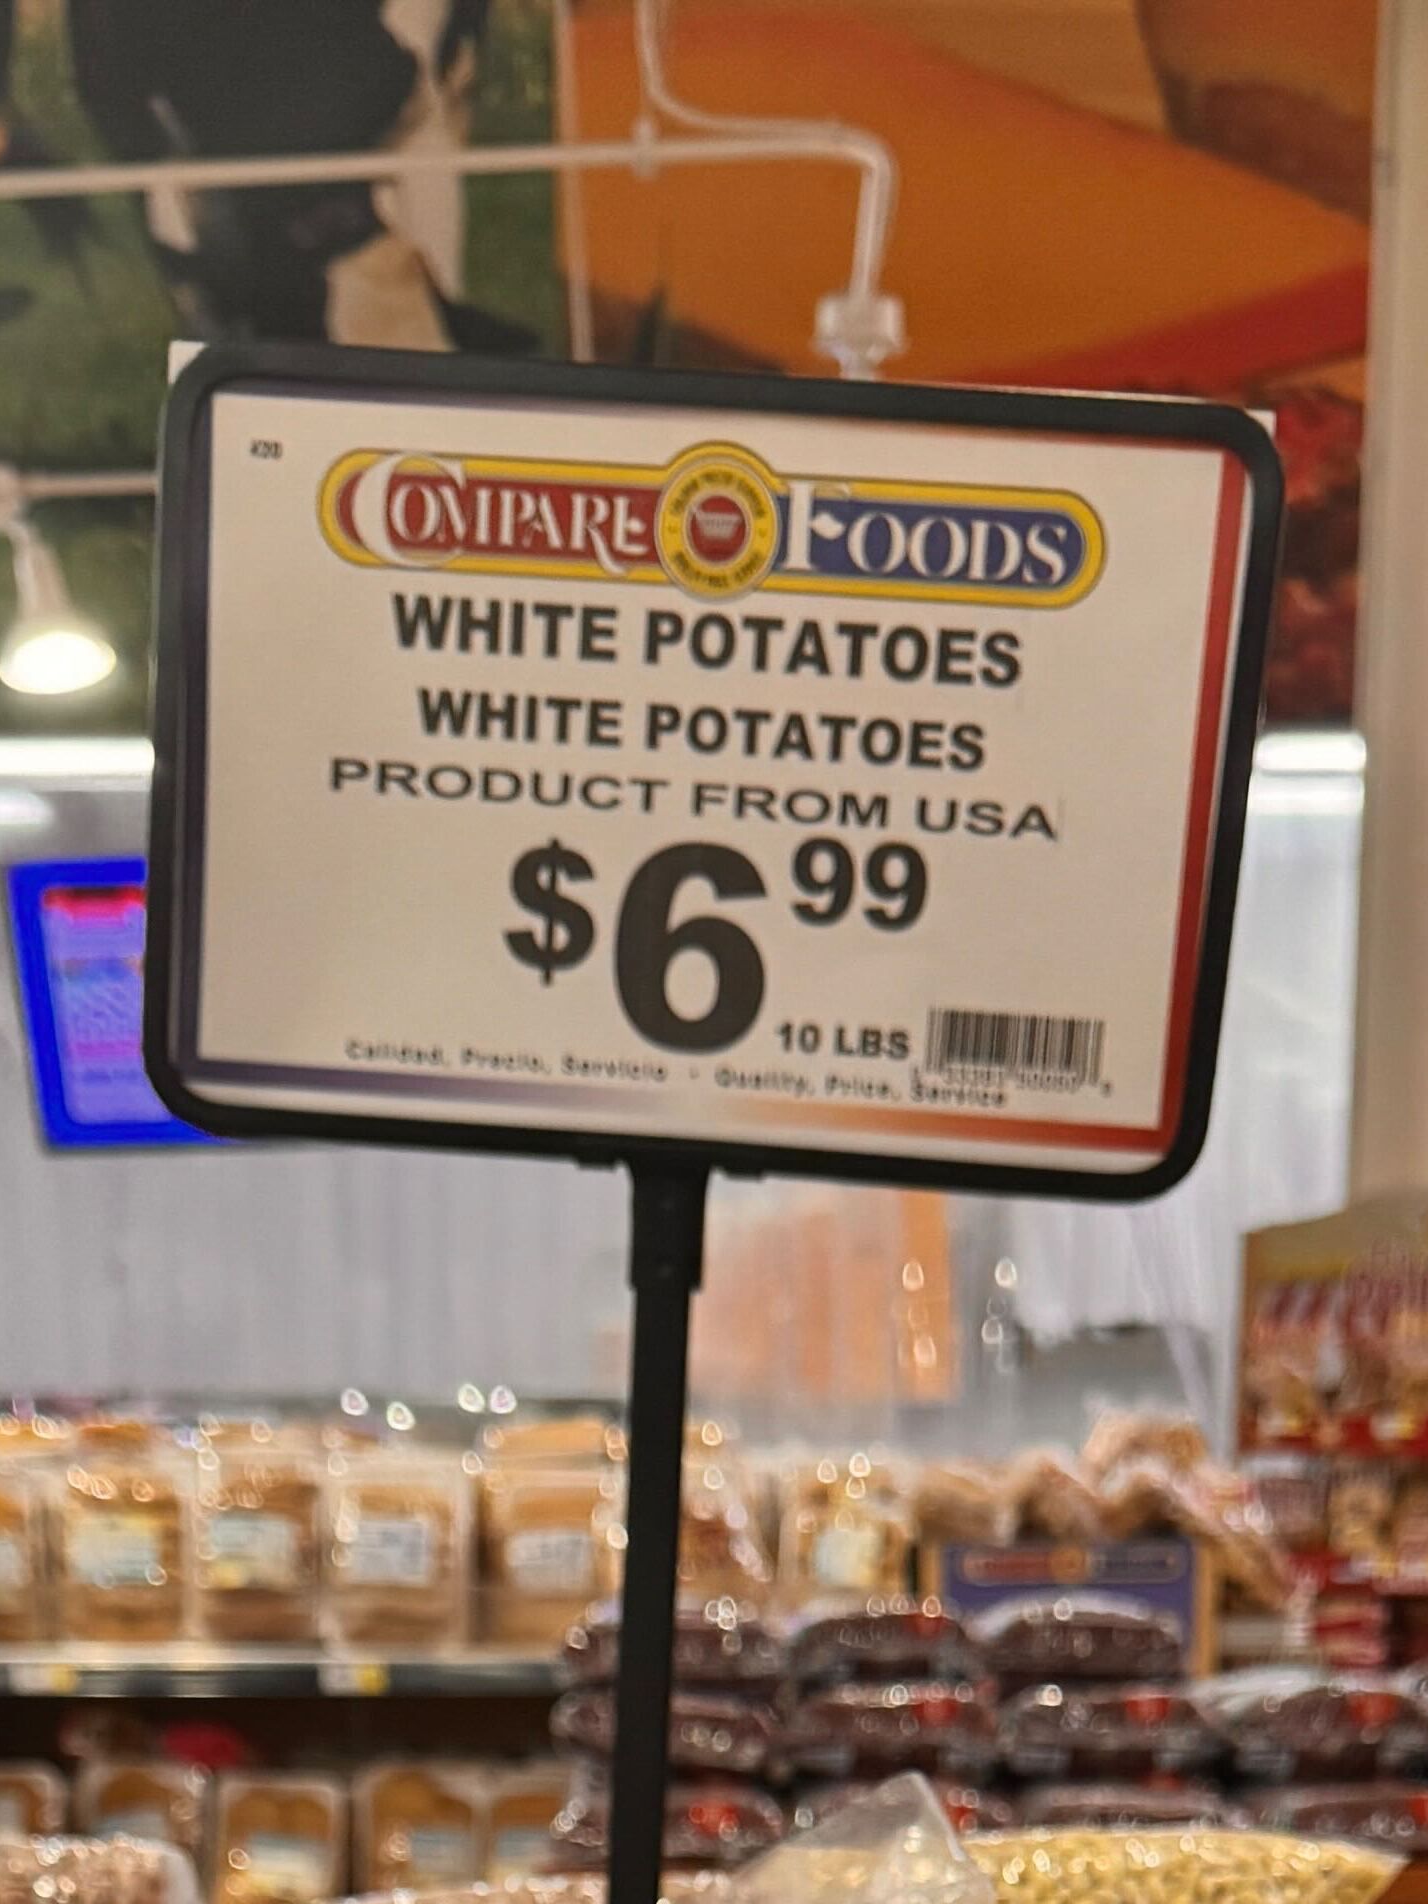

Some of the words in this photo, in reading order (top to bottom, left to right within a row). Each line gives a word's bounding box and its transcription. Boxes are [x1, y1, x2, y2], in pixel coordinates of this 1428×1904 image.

[352, 453, 650, 576] COMPARE
[784, 481, 1068, 586] FOODS
[392, 593, 619, 661] WHITE
[643, 609, 1022, 688] POTATOES
[418, 687, 622, 747] WHITE
[644, 704, 986, 771] POTATOES
[330, 758, 668, 813] PRODUCT
[691, 783, 889, 829] FROM
[916, 797, 1058, 841] USA
[793, 836, 928, 931] 99
[779, 1022, 820, 1053] 10
[834, 1027, 910, 1059] LBS
